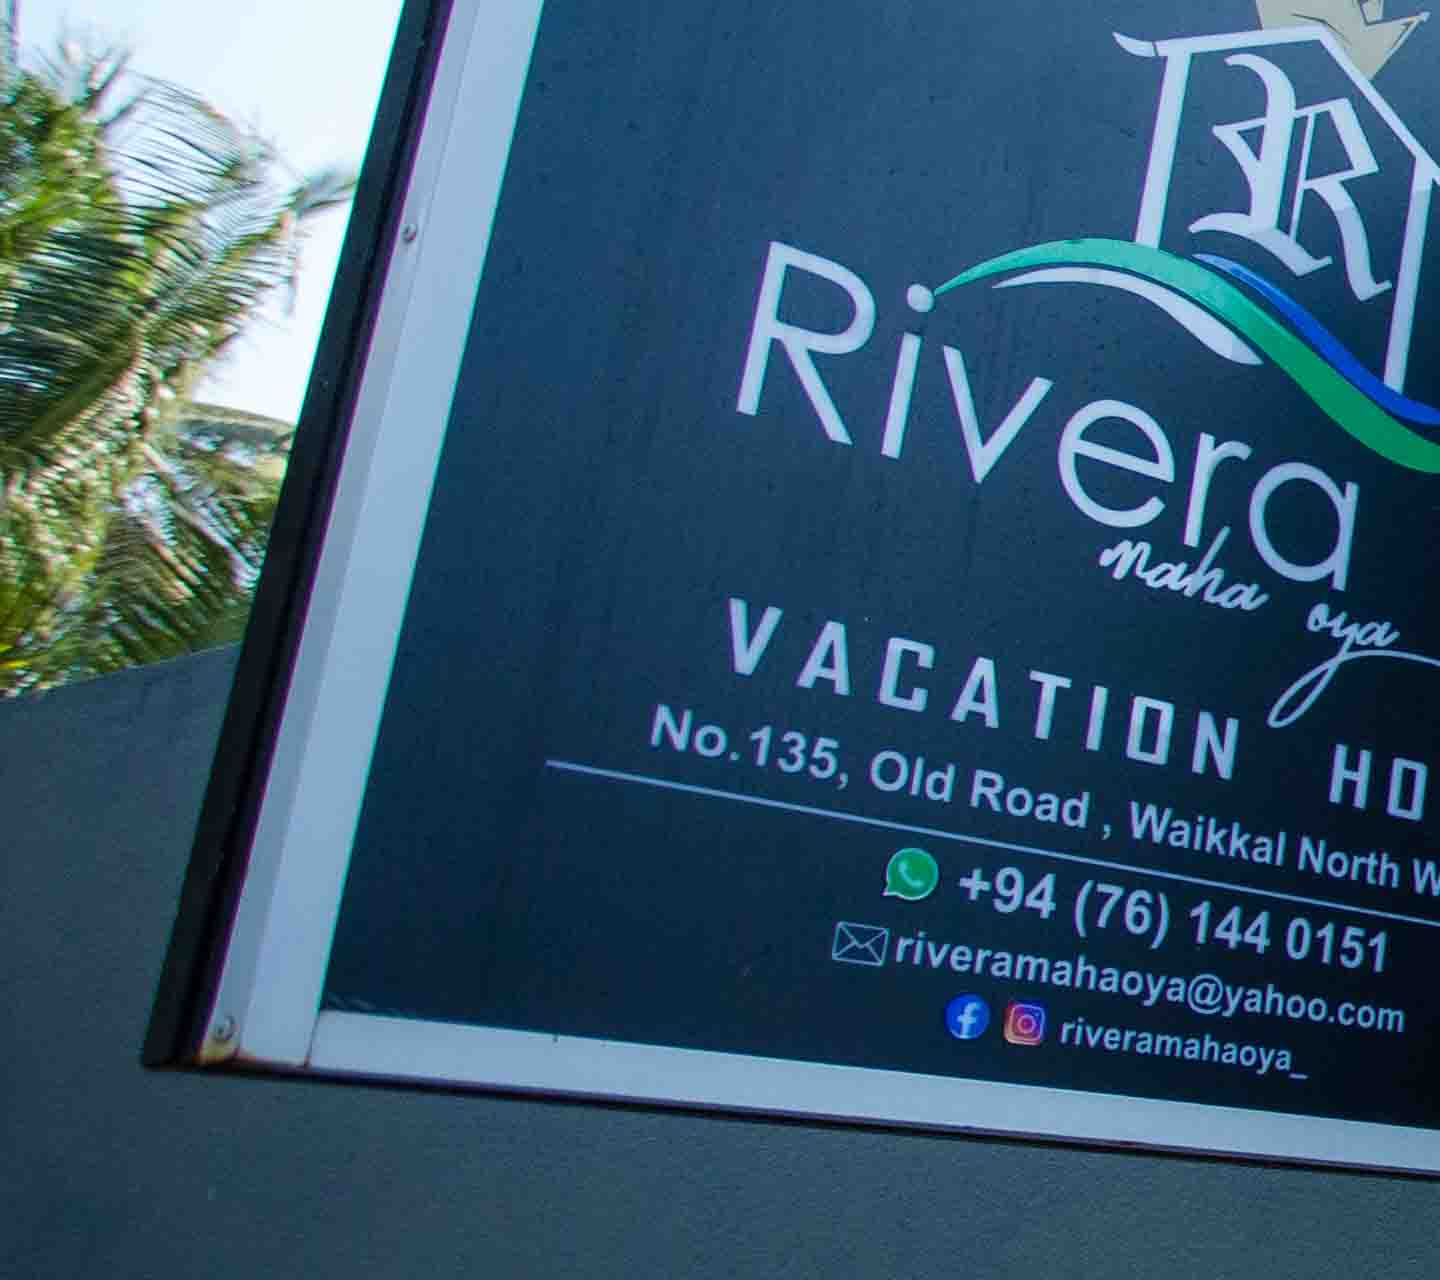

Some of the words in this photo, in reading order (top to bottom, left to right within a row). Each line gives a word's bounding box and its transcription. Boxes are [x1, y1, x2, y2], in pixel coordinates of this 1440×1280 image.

[735, 240, 1359, 592] Rivera
[728, 597, 1240, 781] VACATION
[870, 749, 956, 803] Old
[969, 769, 1091, 829] Road
[1129, 800, 1287, 867] Waikkal
[1297, 836, 1401, 889] North
[959, 865, 1057, 920] +94
[1073, 879, 1170, 950] (76)
[1189, 900, 1271, 955] 144
[1285, 917, 1387, 973] 0151
[894, 931, 1405, 1034] riveramahaoya@yahoo.com
[1059, 1017, 1308, 1080] riveramahaoya_
